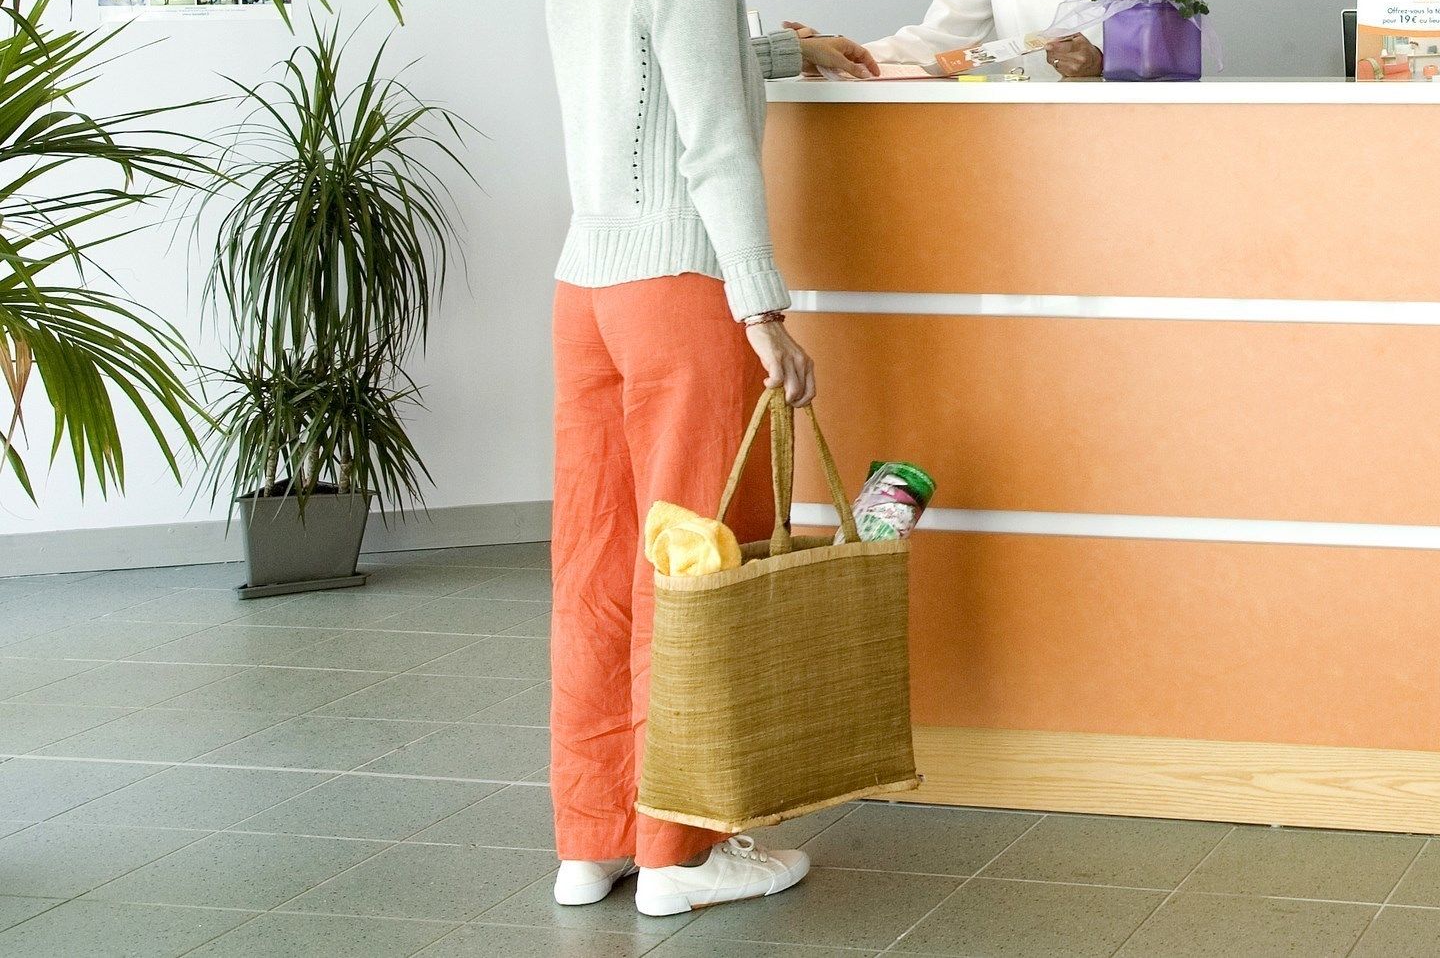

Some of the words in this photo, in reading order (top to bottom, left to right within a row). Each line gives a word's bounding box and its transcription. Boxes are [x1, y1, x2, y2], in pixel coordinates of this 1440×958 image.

[1387, 6, 1425, 14] Offrez-vous
[1400, 14, 1417, 24] 19€
[1429, 16, 1440, 24] lieu
